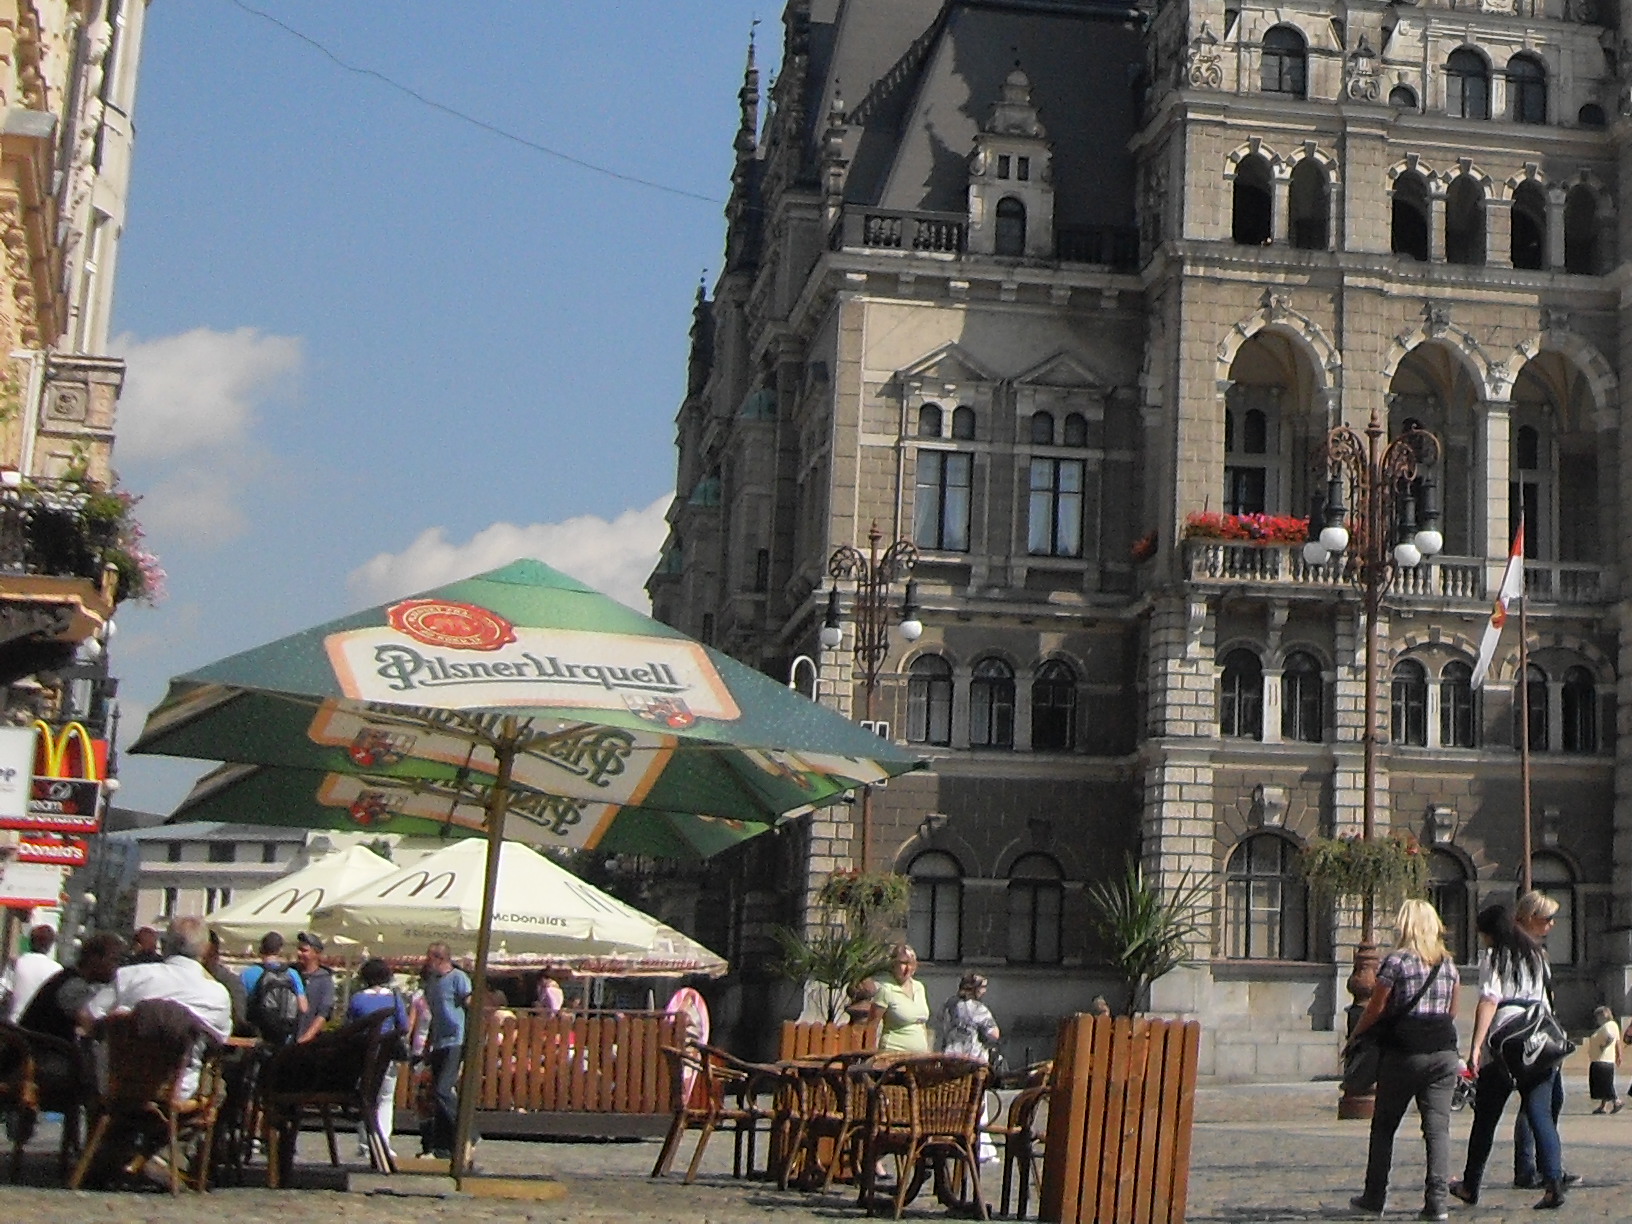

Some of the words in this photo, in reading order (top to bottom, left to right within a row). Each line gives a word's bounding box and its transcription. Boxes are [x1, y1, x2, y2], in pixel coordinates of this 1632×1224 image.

[374, 644, 531, 691] Pilsner
[521, 652, 680, 691] Urquell
[18, 842, 84, 859] Donald's
[492, 913, 567, 927] McDonald's
